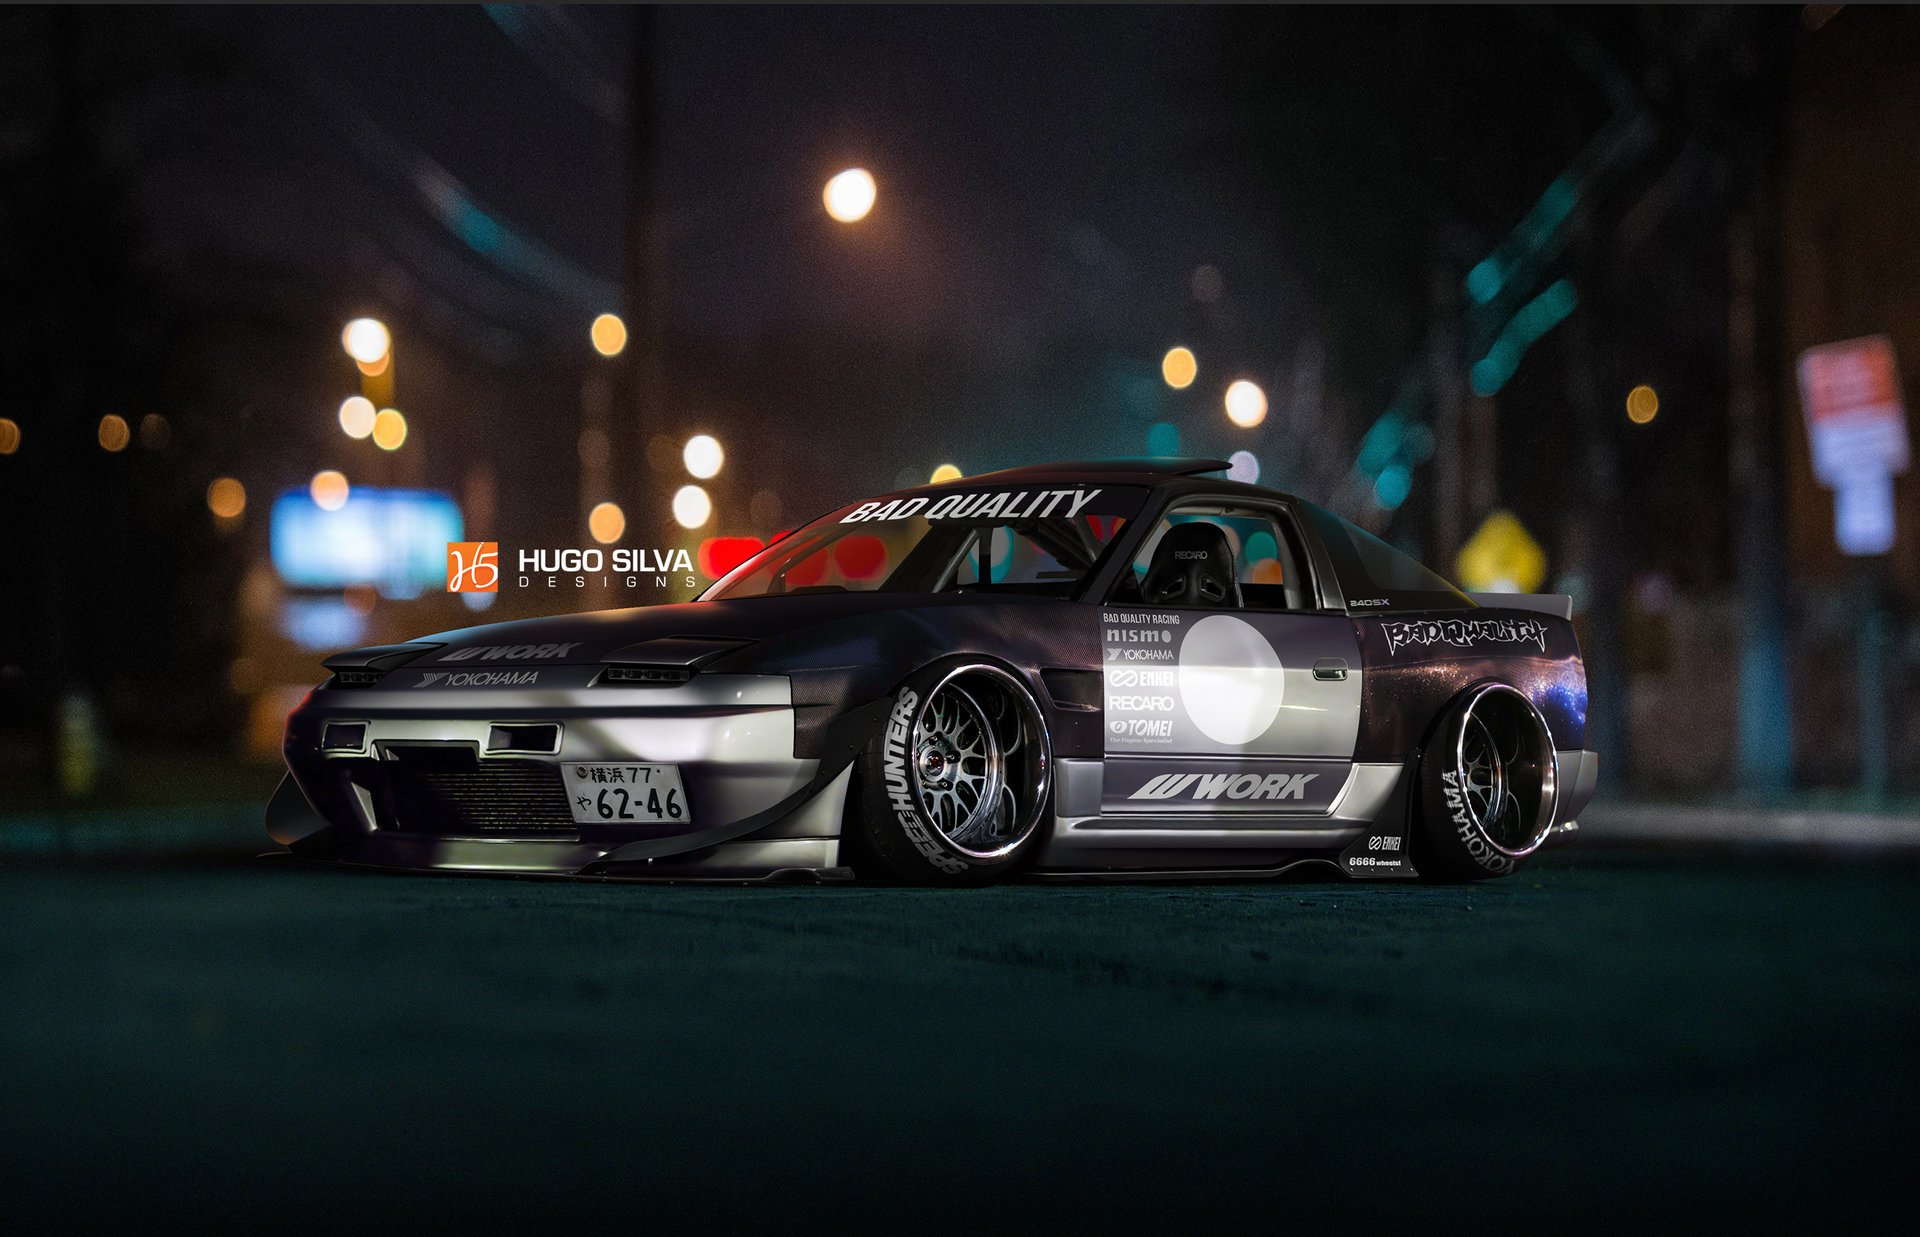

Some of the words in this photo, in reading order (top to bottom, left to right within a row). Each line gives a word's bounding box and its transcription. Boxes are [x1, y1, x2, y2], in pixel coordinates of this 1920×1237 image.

[839, 497, 930, 524] BAD
[924, 489, 1102, 520] QUALITY
[1174, 550, 1208, 561] RECARO
[1350, 598, 1390, 607] 240SX
[1103, 612, 1119, 623] BAD
[1120, 613, 1151, 624] QUALITY
[1152, 614, 1180, 625] RACING
[480, 642, 585, 661] WORK
[1123, 649, 1174, 660] YOKOHAMA
[444, 671, 539, 687] YOKOHAMA
[1140, 671, 1173, 687] ENKEI
[1109, 695, 1175, 712] RECARO
[1128, 719, 1173, 737] TOMEI
[590, 767, 625, 784] 横浜
[626, 767, 651, 783] 77
[1192, 773, 1320, 800] WORK
[597, 788, 682, 819] 62-46
[1442, 770, 1515, 875] YOKOHAMA
[1349, 857, 1376, 866] 6666
